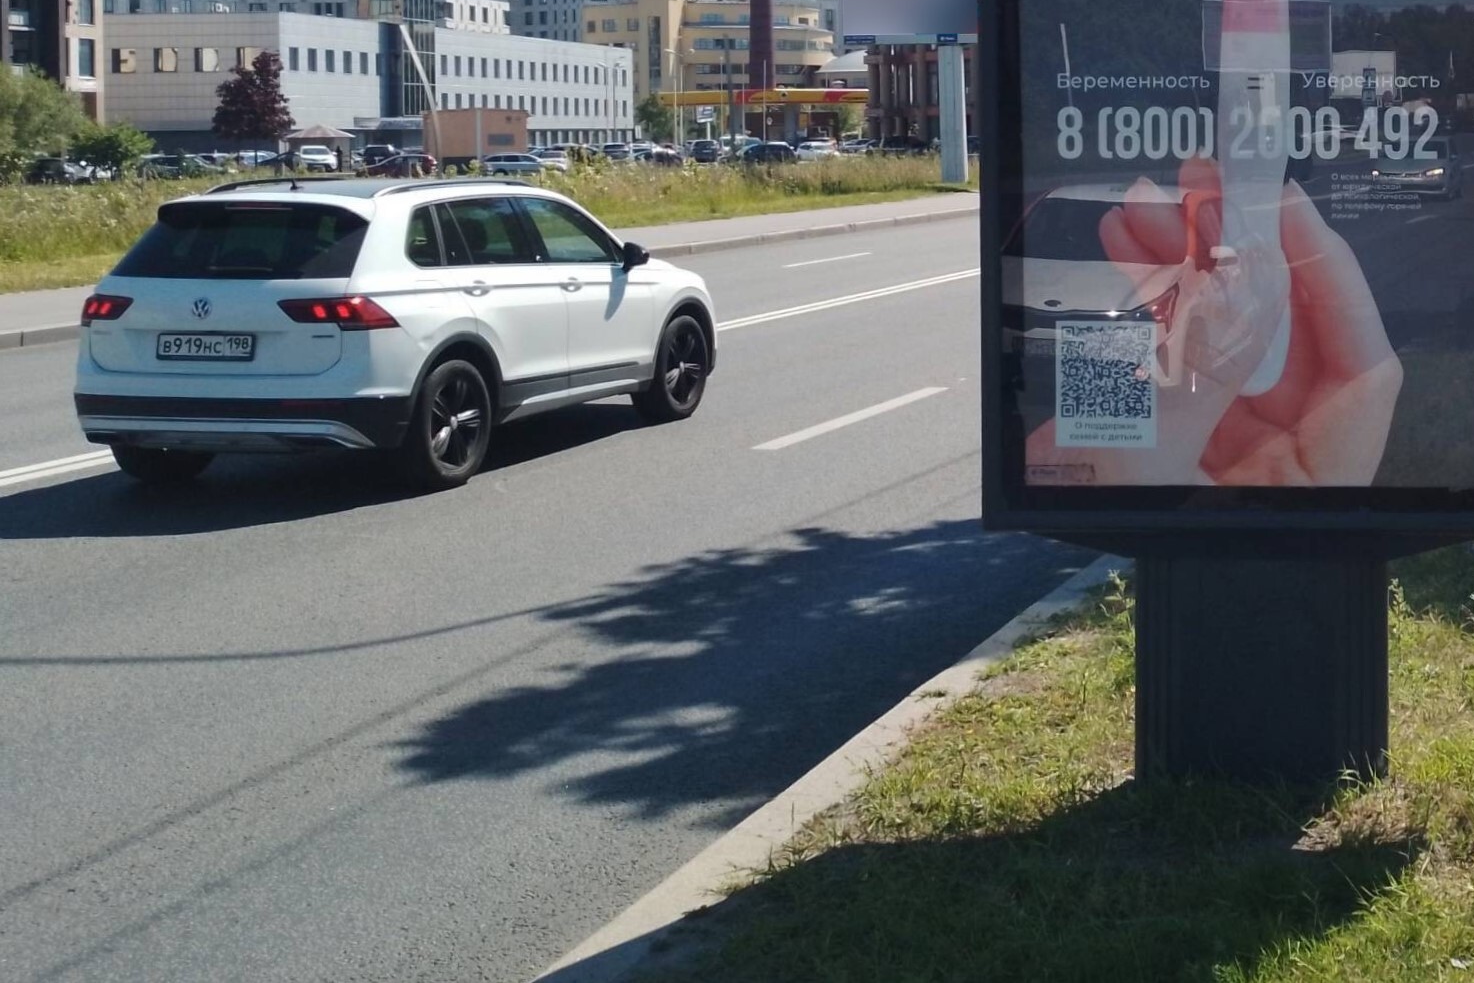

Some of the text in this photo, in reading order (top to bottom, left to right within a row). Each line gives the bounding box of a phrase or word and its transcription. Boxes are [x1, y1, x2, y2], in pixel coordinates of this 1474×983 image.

[1056, 72, 1211, 93] Беременность
[1301, 72, 1441, 91] Уверенность
[1057, 106, 1439, 160] 8 (800) 2000 492
